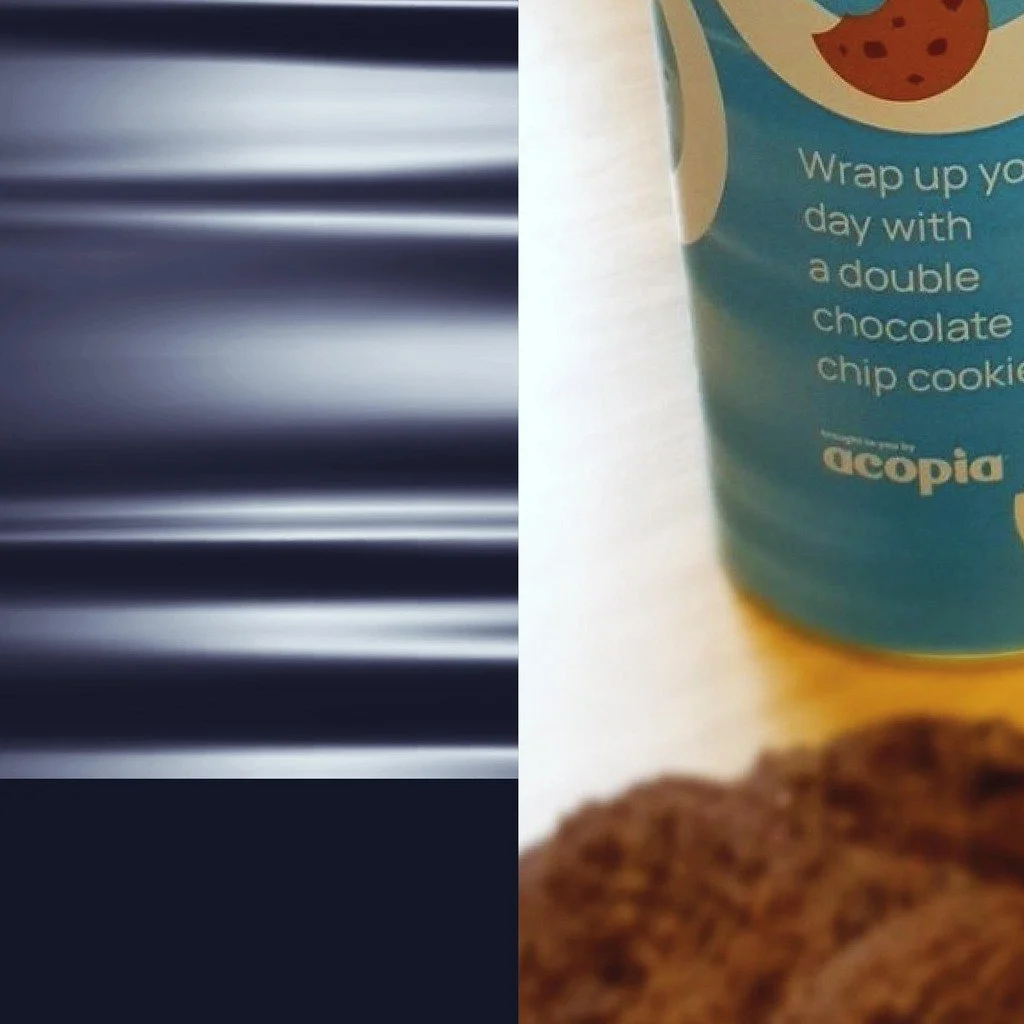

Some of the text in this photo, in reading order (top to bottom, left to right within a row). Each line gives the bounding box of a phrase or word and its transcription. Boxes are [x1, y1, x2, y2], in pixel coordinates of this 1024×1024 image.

[798, 147, 904, 199] Wrap
[914, 163, 969, 199] up
[804, 203, 973, 246] day with
[808, 257, 980, 294] a double
[812, 305, 1013, 344] chocolate
[816, 354, 897, 396] chip
[822, 446, 1003, 496] acopia
